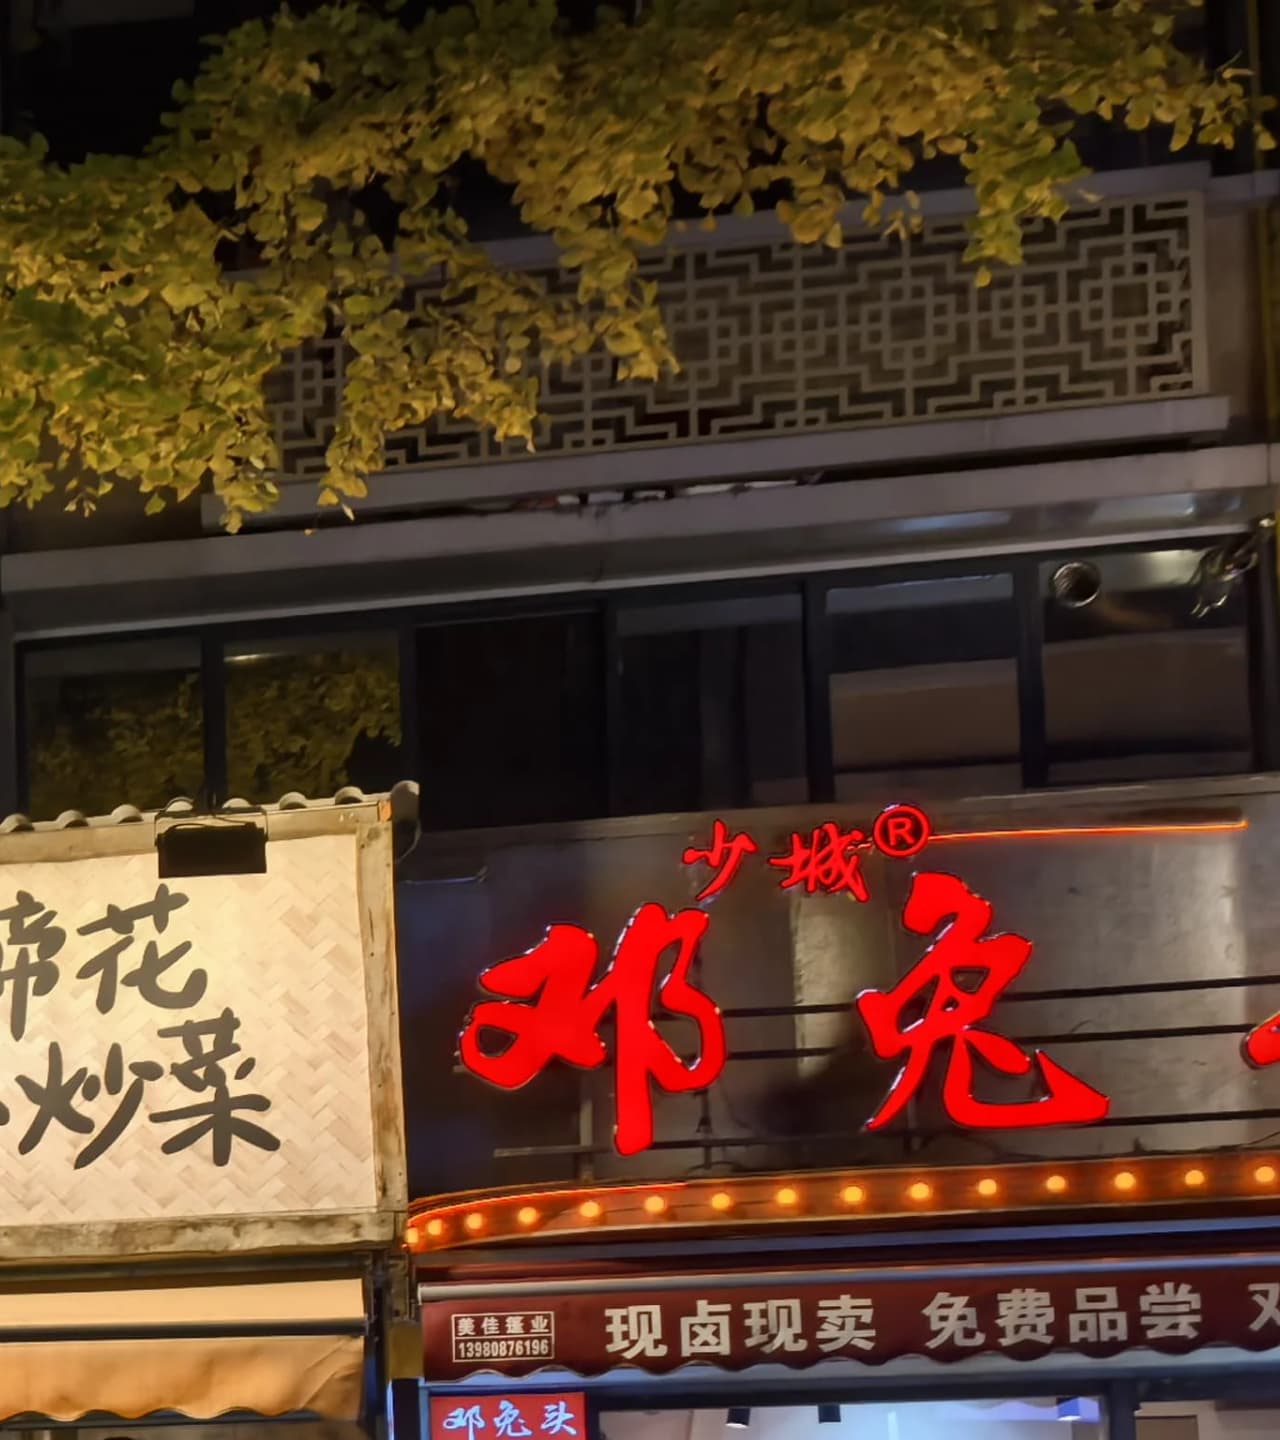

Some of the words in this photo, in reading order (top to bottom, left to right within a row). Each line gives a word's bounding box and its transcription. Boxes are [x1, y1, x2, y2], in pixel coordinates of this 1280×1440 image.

[458, 870, 1280, 1156] 邓兔
[458, 1338, 550, 1359] 13980876196
[604, 1298, 878, 1361] 现卤现卖
[921, 1281, 1203, 1349] 免费品尝
